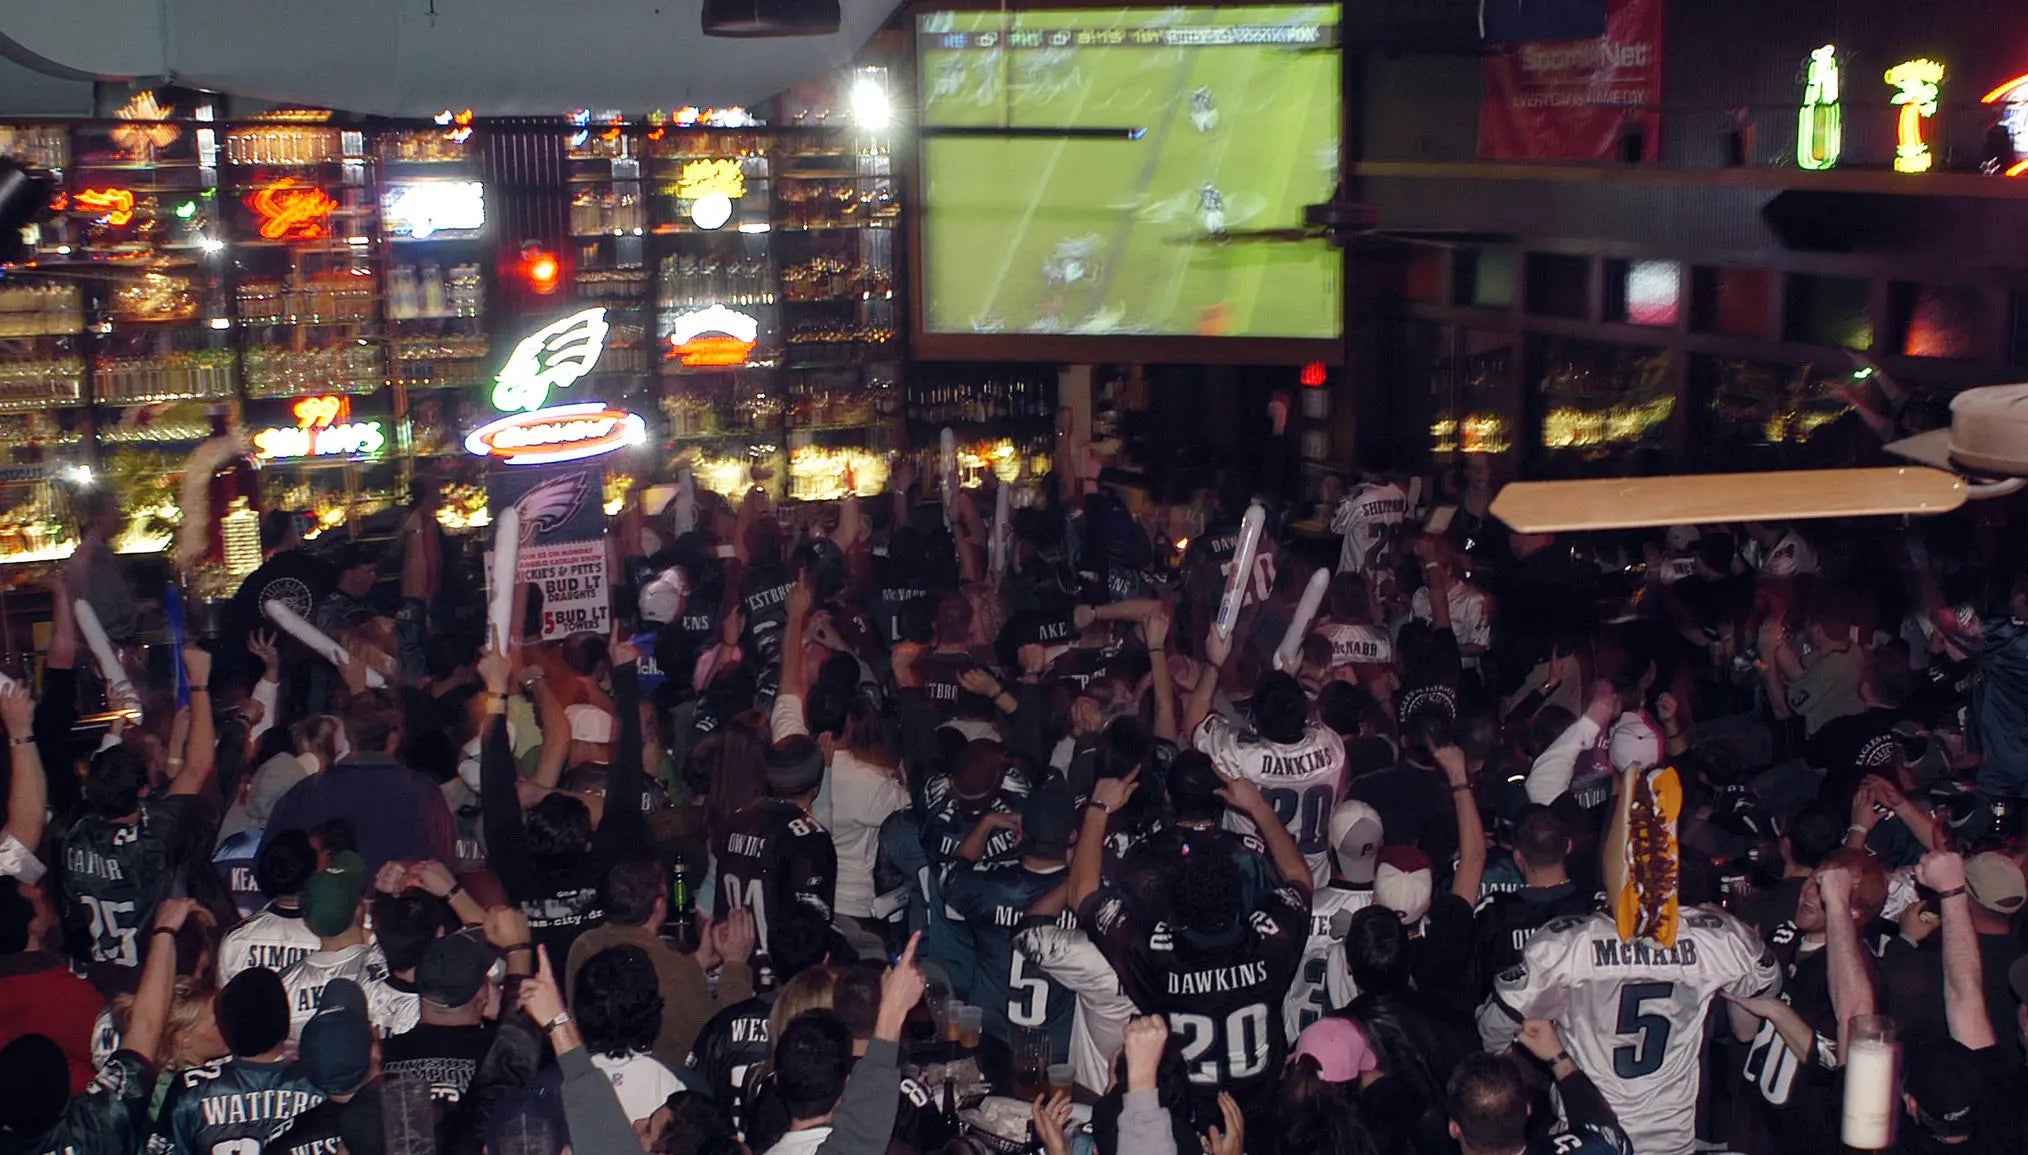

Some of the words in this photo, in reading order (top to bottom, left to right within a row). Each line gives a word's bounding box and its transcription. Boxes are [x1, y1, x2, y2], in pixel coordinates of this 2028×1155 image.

[570, 562, 602, 574] PETE'S
[545, 578, 579, 594] BUD
[585, 575, 601, 589] LT
[548, 589, 596, 602] DRAUGHTS
[544, 611, 555, 634] 5
[555, 608, 586, 625] BUD
[592, 606, 608, 621] LT
[563, 620, 600, 632] TOWERS
[1261, 747, 1332, 776] DAWKINS
[1007, 949, 1050, 1028] 5
[1167, 960, 1268, 995] DAWKINS
[1168, 1001, 1269, 1084] 20
[1612, 982, 1674, 1080] 5
